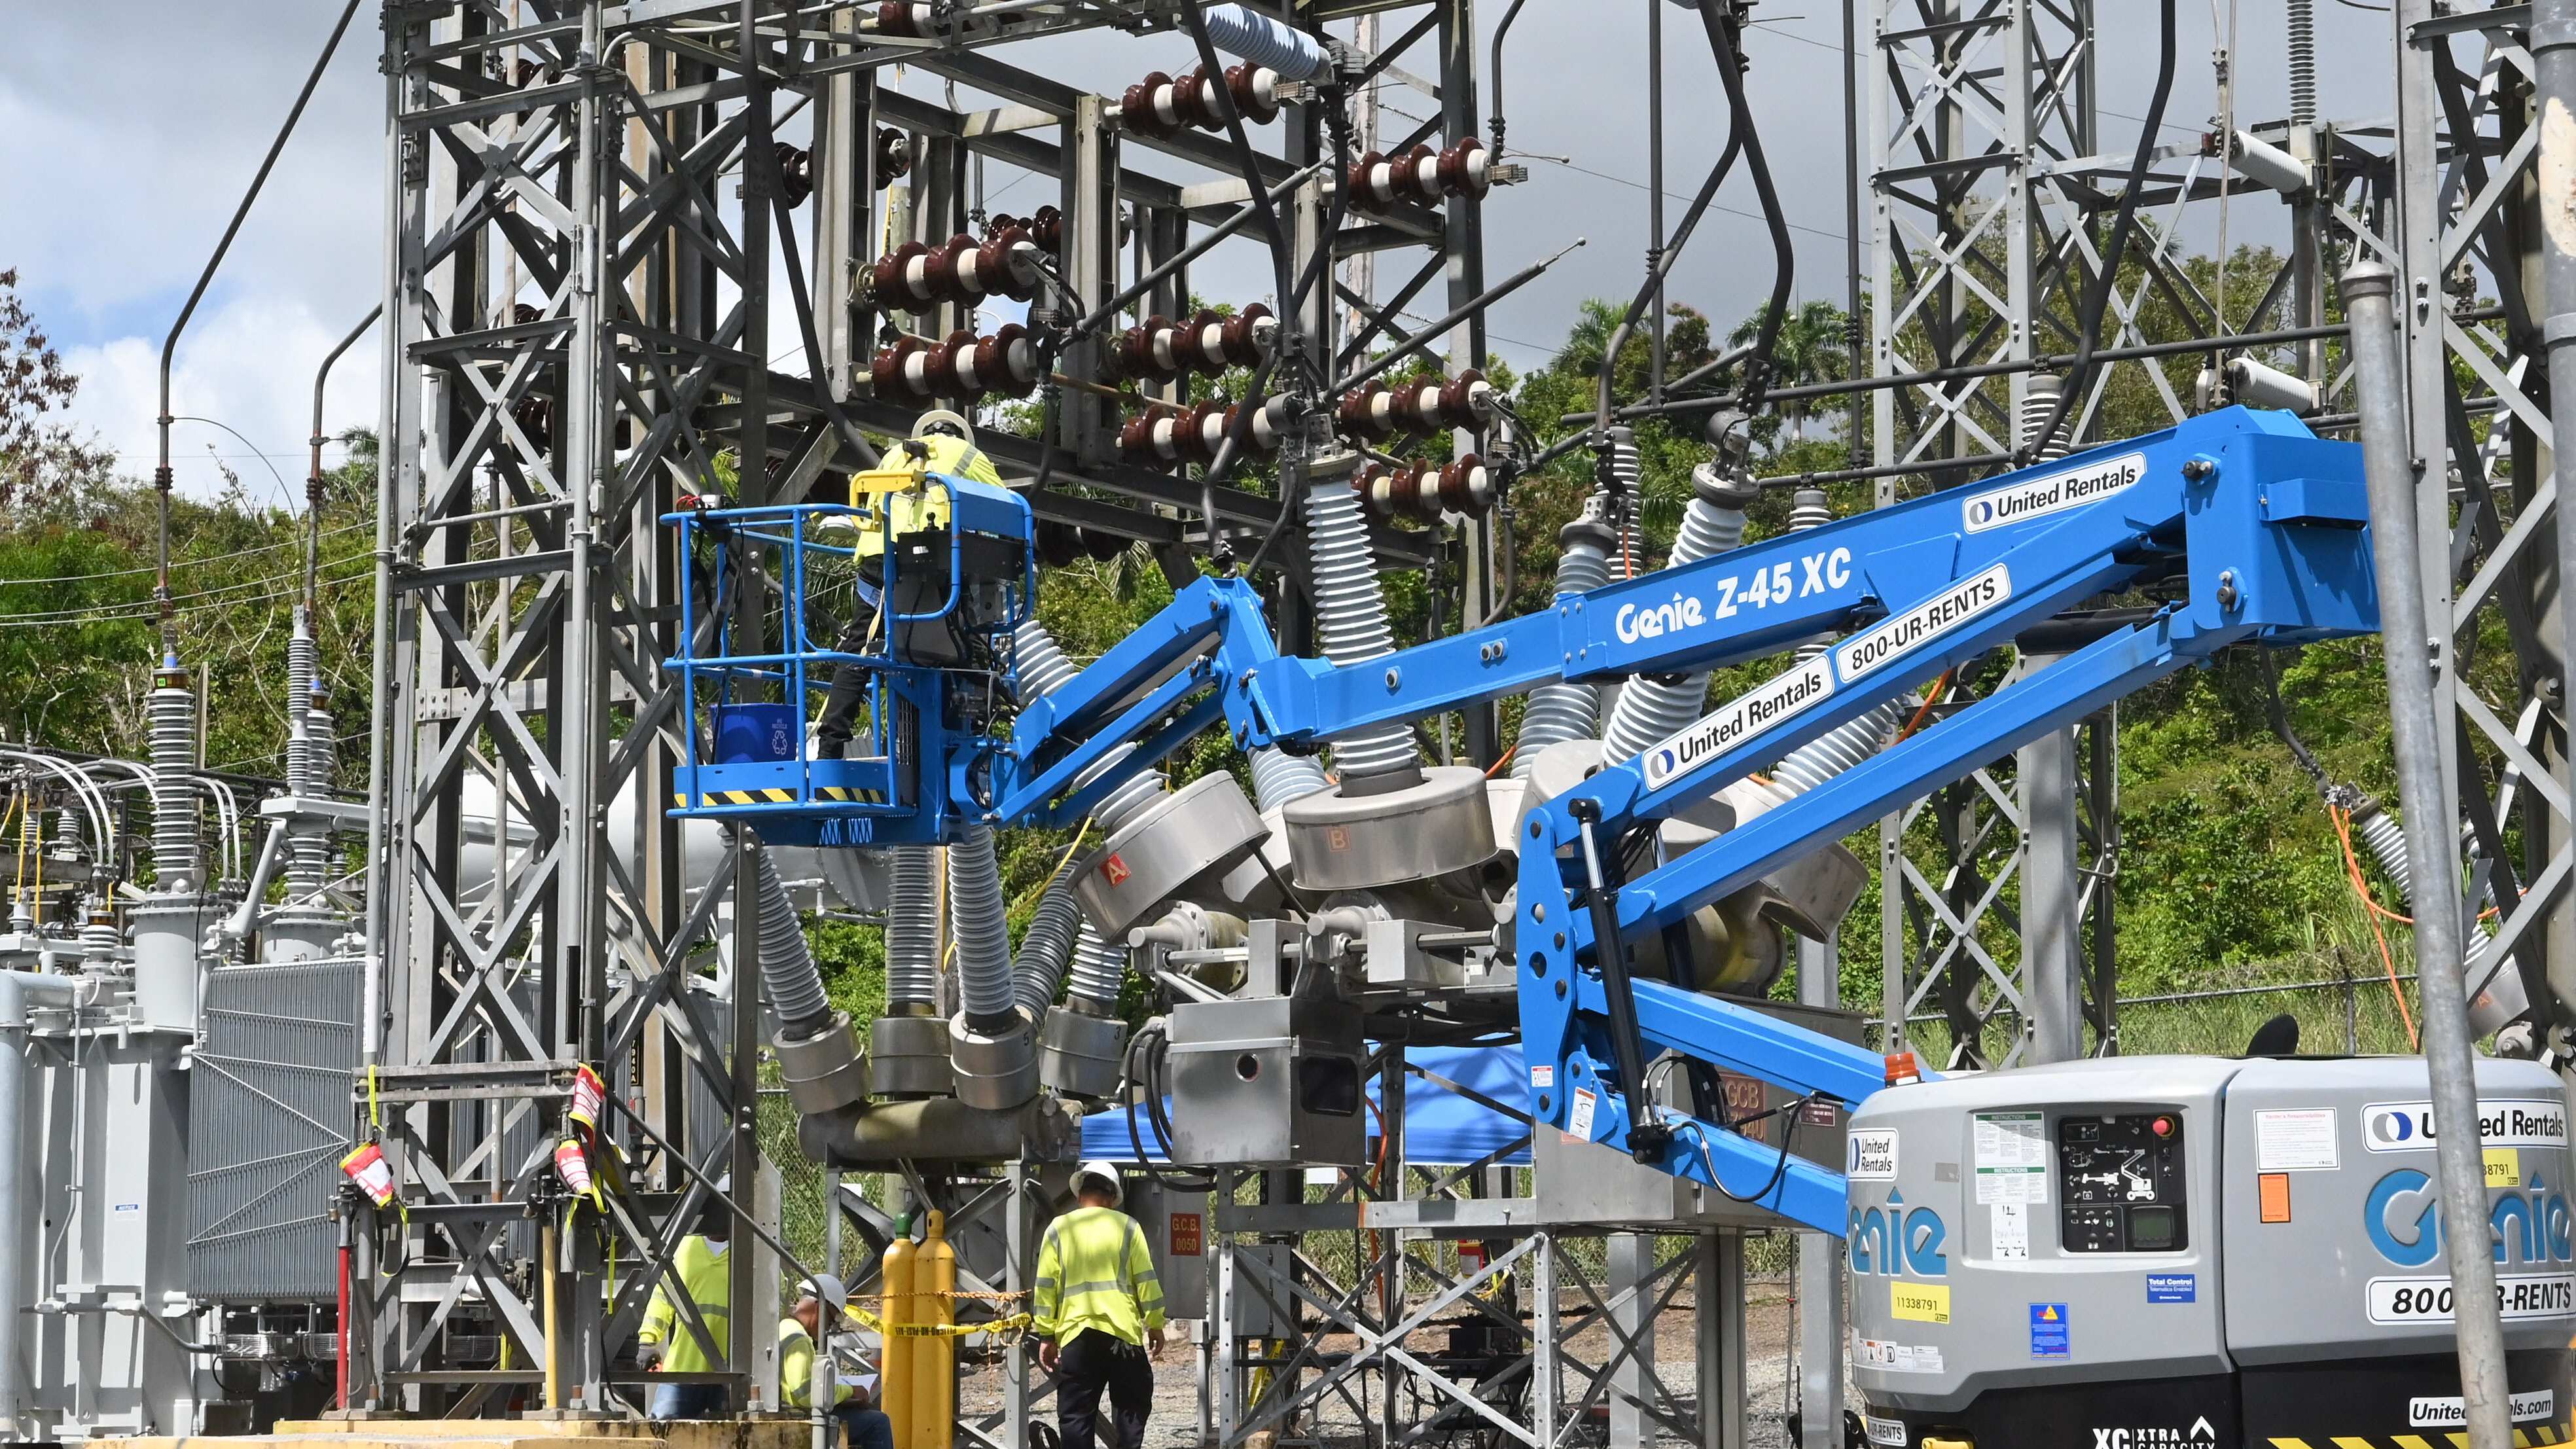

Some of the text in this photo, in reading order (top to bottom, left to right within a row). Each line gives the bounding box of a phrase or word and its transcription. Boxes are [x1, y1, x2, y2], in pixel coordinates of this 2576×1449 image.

[1998, 465, 2136, 517] United Rentals
[1616, 547, 1851, 644] Genie Z-45 XC
[1852, 577, 1995, 670] 800-UR-RENTS
[1679, 672, 1821, 763] United Rentals
[1332, 831, 1346, 850] B
[1107, 862, 1126, 885] A
[1023, 1031, 1029, 1046] 5
[1115, 1026, 1121, 1040] 3
[1726, 1080, 1759, 1108] GCB
[2422, 1109, 2564, 1138] Ued Rentals
[1862, 1138, 1890, 1154] United
[1861, 1156, 1892, 1172] Rentals
[2482, 1164, 2509, 1176] 38791
[2364, 1168, 2572, 1268] Gnie
[1850, 1186, 1947, 1277] enie
[1177, 1238, 1196, 1251] 0050
[1897, 1297, 1937, 1312] 11338791
[2392, 1281, 2571, 1314] 800R-RENTS
[2092, 1428, 2131, 1449] XC
[2137, 1429, 2180, 1441] XTRA
